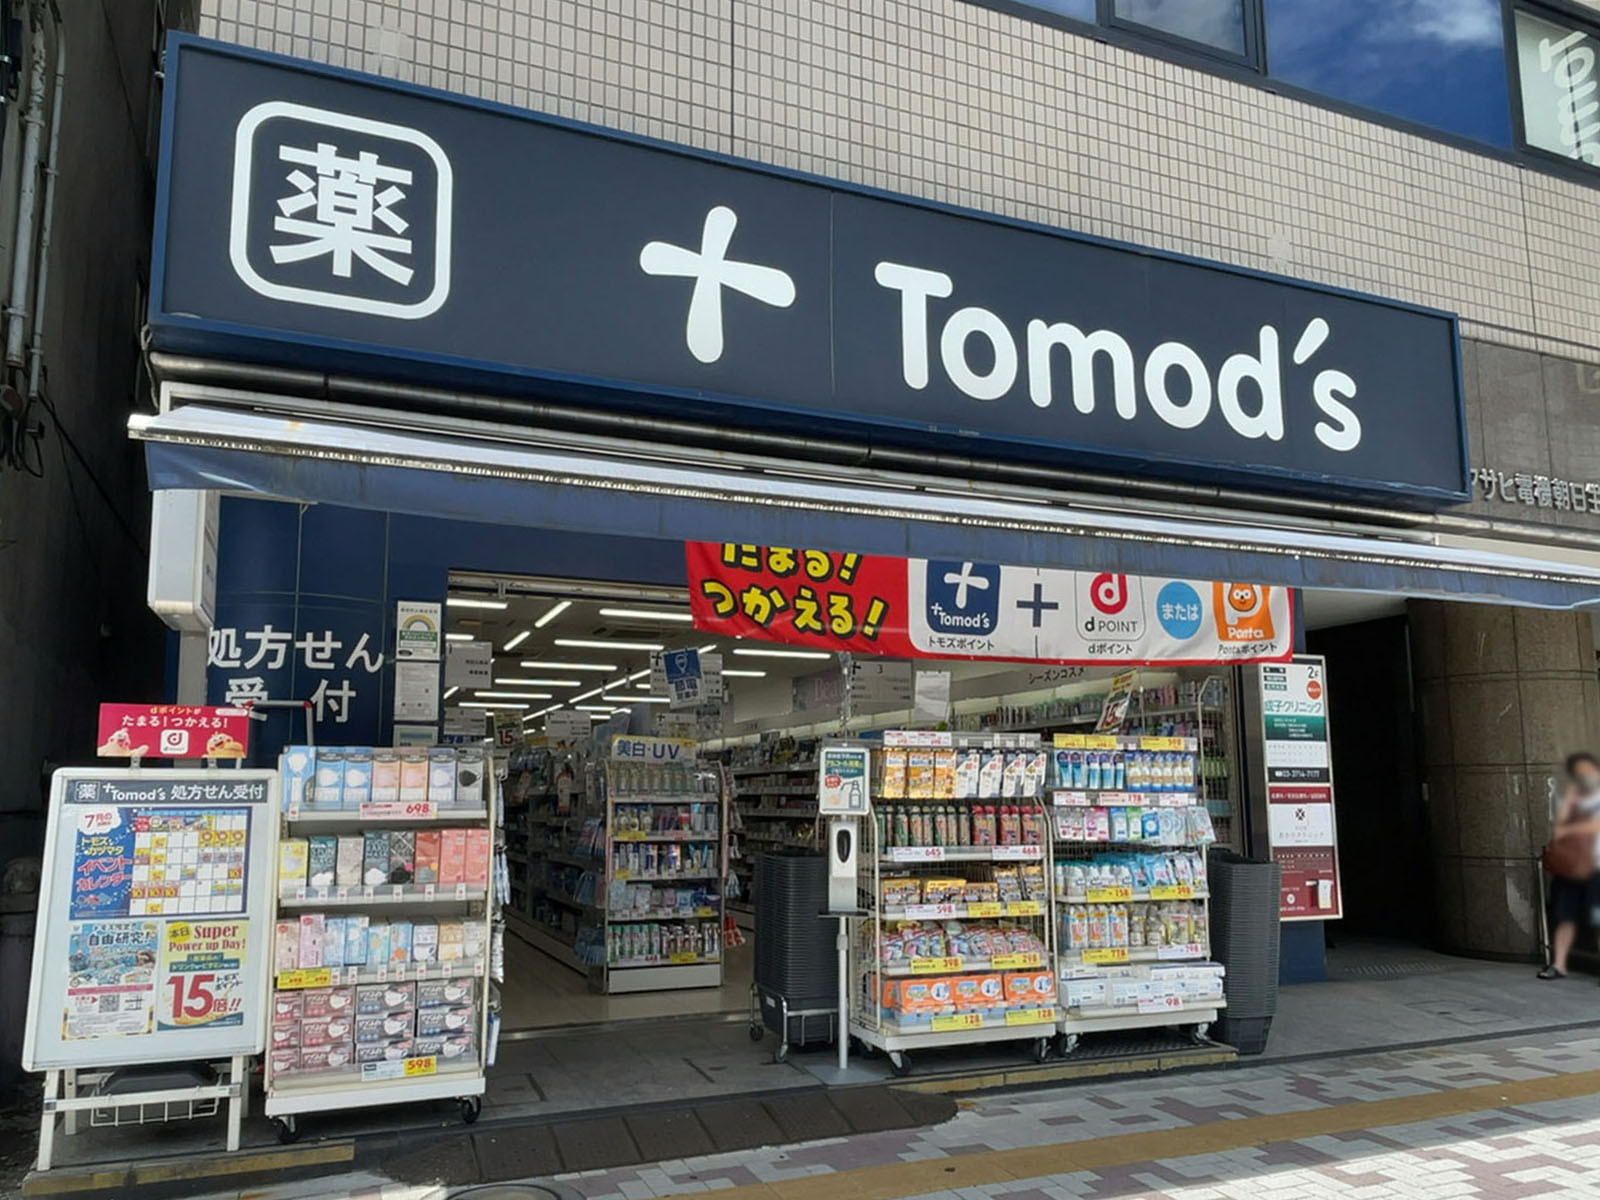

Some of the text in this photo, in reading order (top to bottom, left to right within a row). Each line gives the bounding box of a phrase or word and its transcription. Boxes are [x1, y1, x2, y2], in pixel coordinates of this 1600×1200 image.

[270, 142, 415, 287] 薬
[874, 261, 1361, 452] Tomod's
[702, 579, 889, 641] つかえる!
[1161, 602, 1200, 622] または
[938, 611, 991, 629] Tomod's
[207, 624, 384, 673] 処方せん
[928, 635, 995, 650] トモズポイント
[111, 787, 166, 801] Tomod's
[170, 784, 263, 800] 処方せん受付
[406, 803, 430, 814] 698
[194, 925, 239, 940] Super
[169, 941, 202, 952] Power
[206, 942, 219, 951] up
[406, 1057, 431, 1070] 598
